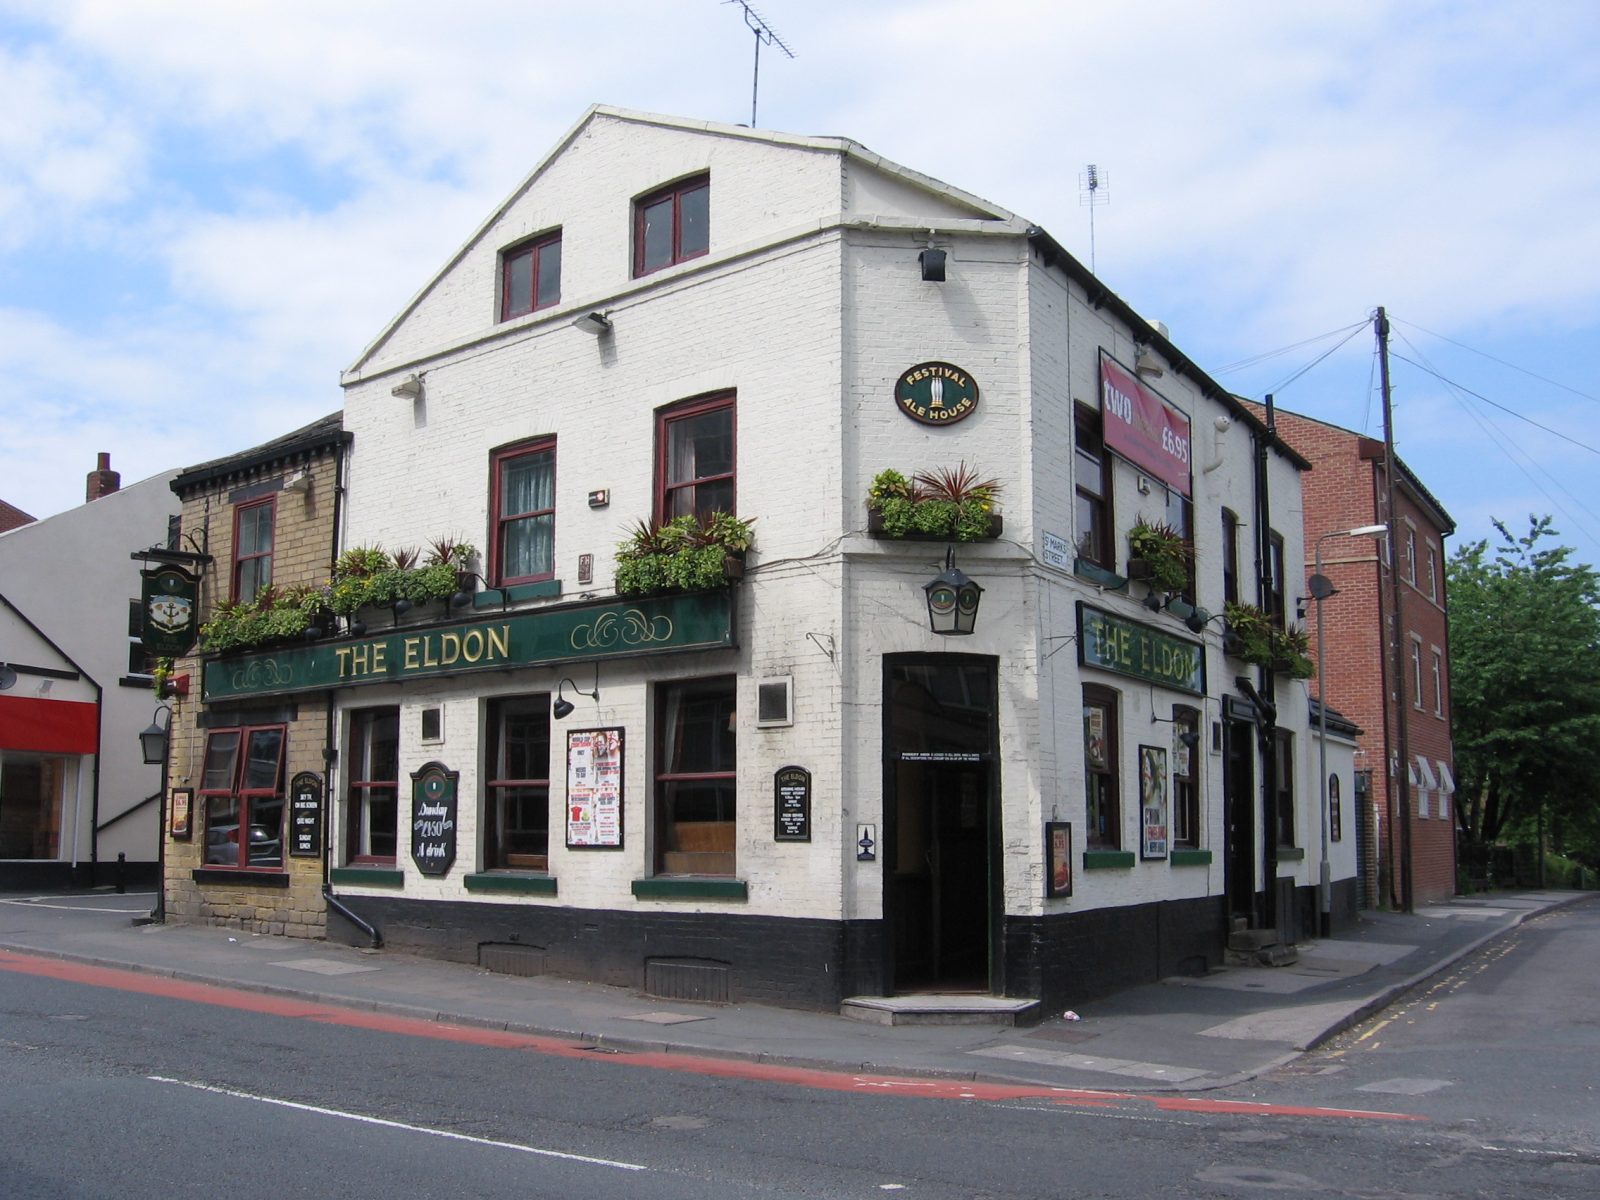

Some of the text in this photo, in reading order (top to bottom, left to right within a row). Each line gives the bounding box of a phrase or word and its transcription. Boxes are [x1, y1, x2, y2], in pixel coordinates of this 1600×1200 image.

[906, 367, 966, 388] FESTIVAL
[903, 397, 972, 420] ALE HOUSE
[1162, 426, 1188, 464] £6.95
[1050, 538, 1067, 554] MARKS
[1044, 549, 1064, 565] STREET
[335, 624, 510, 678] THE ELDON
[1091, 620, 1196, 682] THE ELDON
[780, 773, 805, 782] THE ELDON
[418, 802, 448, 823] Sunday
